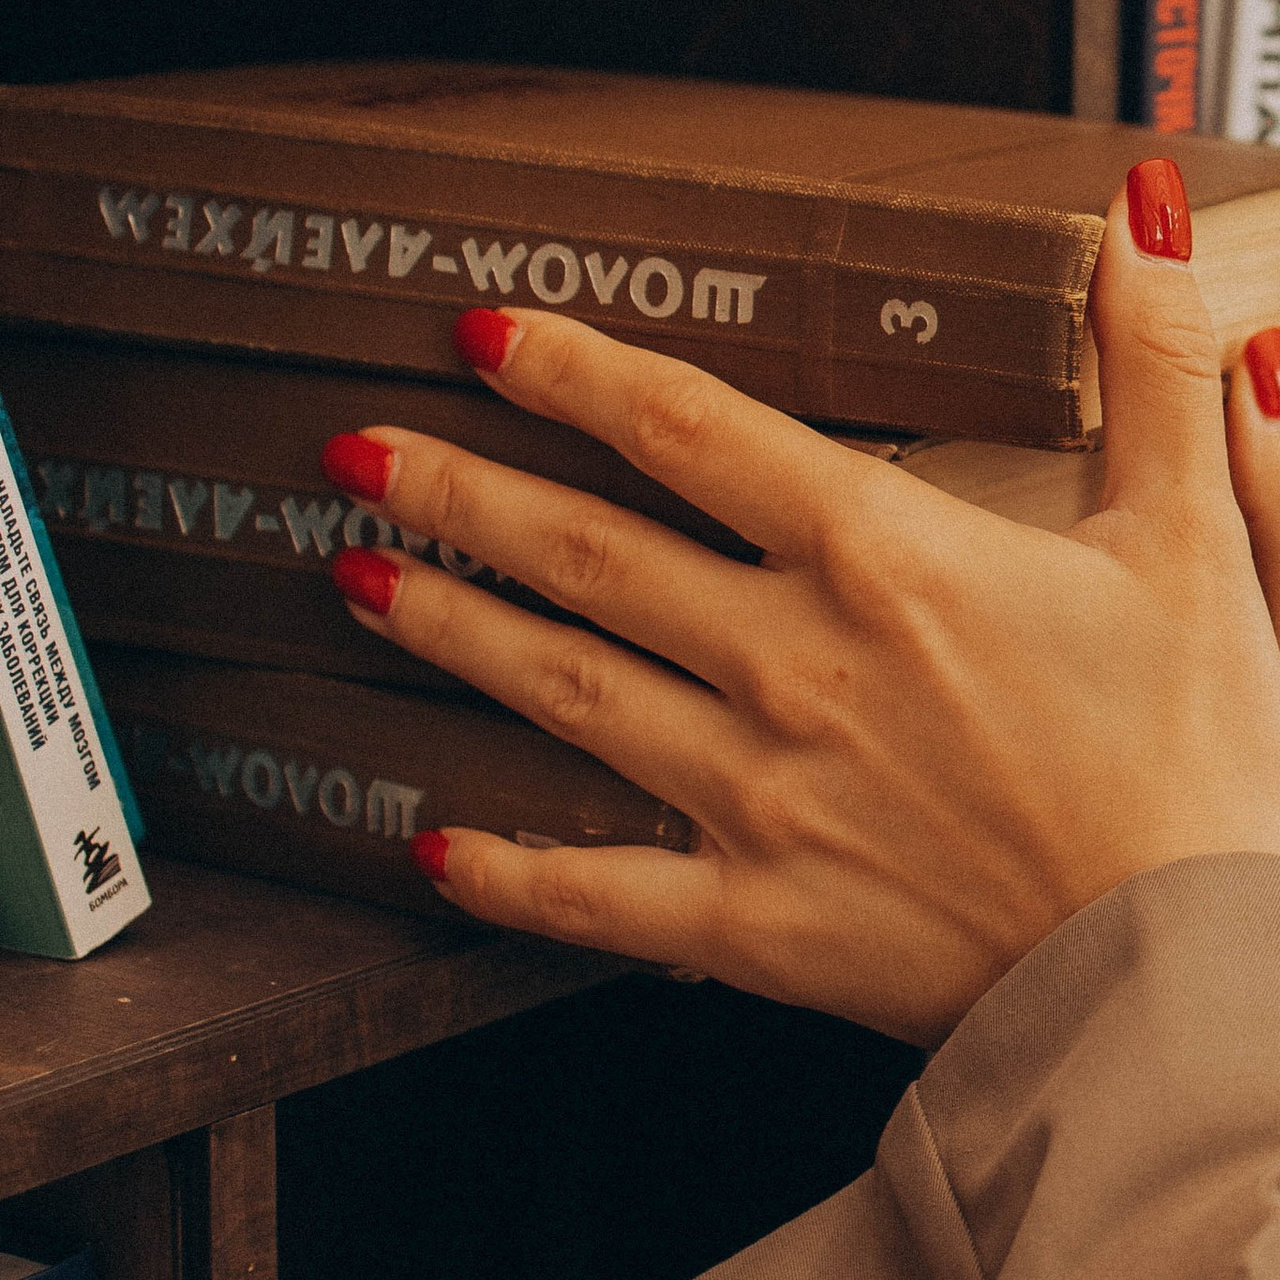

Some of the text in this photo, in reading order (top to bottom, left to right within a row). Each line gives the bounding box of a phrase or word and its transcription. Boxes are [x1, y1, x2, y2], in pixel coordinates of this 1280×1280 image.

[99, 186, 767, 325] ШОЛОМ-АЛЕЙХЕМ
[880, 298, 939, 345] 3
[0, 622, 48, 752] ЗАБОЛЕВАНИЙ
[2, 577, 26, 619] ДЛЯ
[17, 619, 60, 727] КОРРЕКЦИИ
[26, 578, 51, 640] СВЯЗЬ
[45, 640, 76, 710] МЕЖДУ
[68, 712, 101, 792] МОЗГОМ
[89, 877, 129, 912] БОМБОРА
